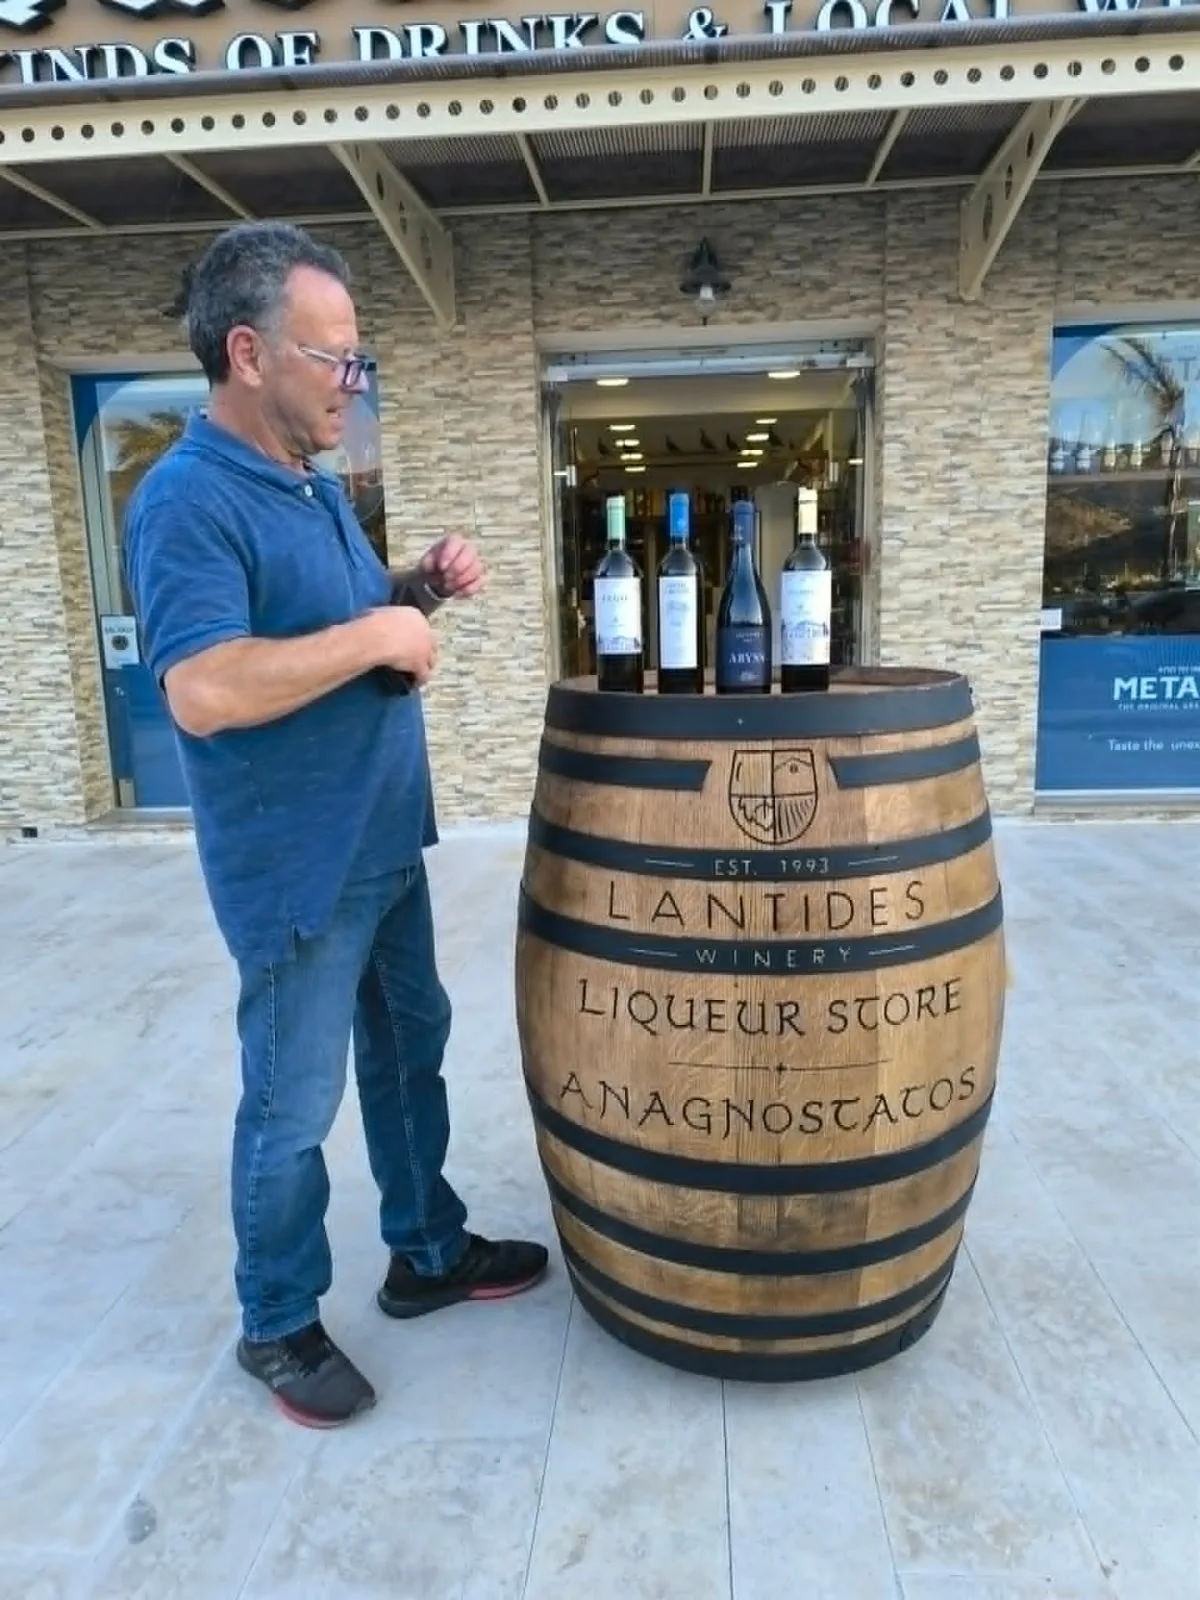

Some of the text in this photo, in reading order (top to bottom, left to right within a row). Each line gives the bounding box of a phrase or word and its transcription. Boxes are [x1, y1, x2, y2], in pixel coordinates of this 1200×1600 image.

[0, 37, 196, 84] INDS
[225, 31, 320, 71] OF
[351, 11, 646, 62] DRINKS
[1113, 676, 1200, 701] META
[1108, 739, 1140, 751] Taste
[1144, 738, 1164, 751] the
[713, 857, 831, 877] EST. 1993
[607, 879, 926, 932] LANTIDES
[695, 946, 853, 969] WINERY
[577, 976, 964, 1037] LIQUEUR STORE
[559, 1066, 977, 1139] ANAGNOSTATOS
